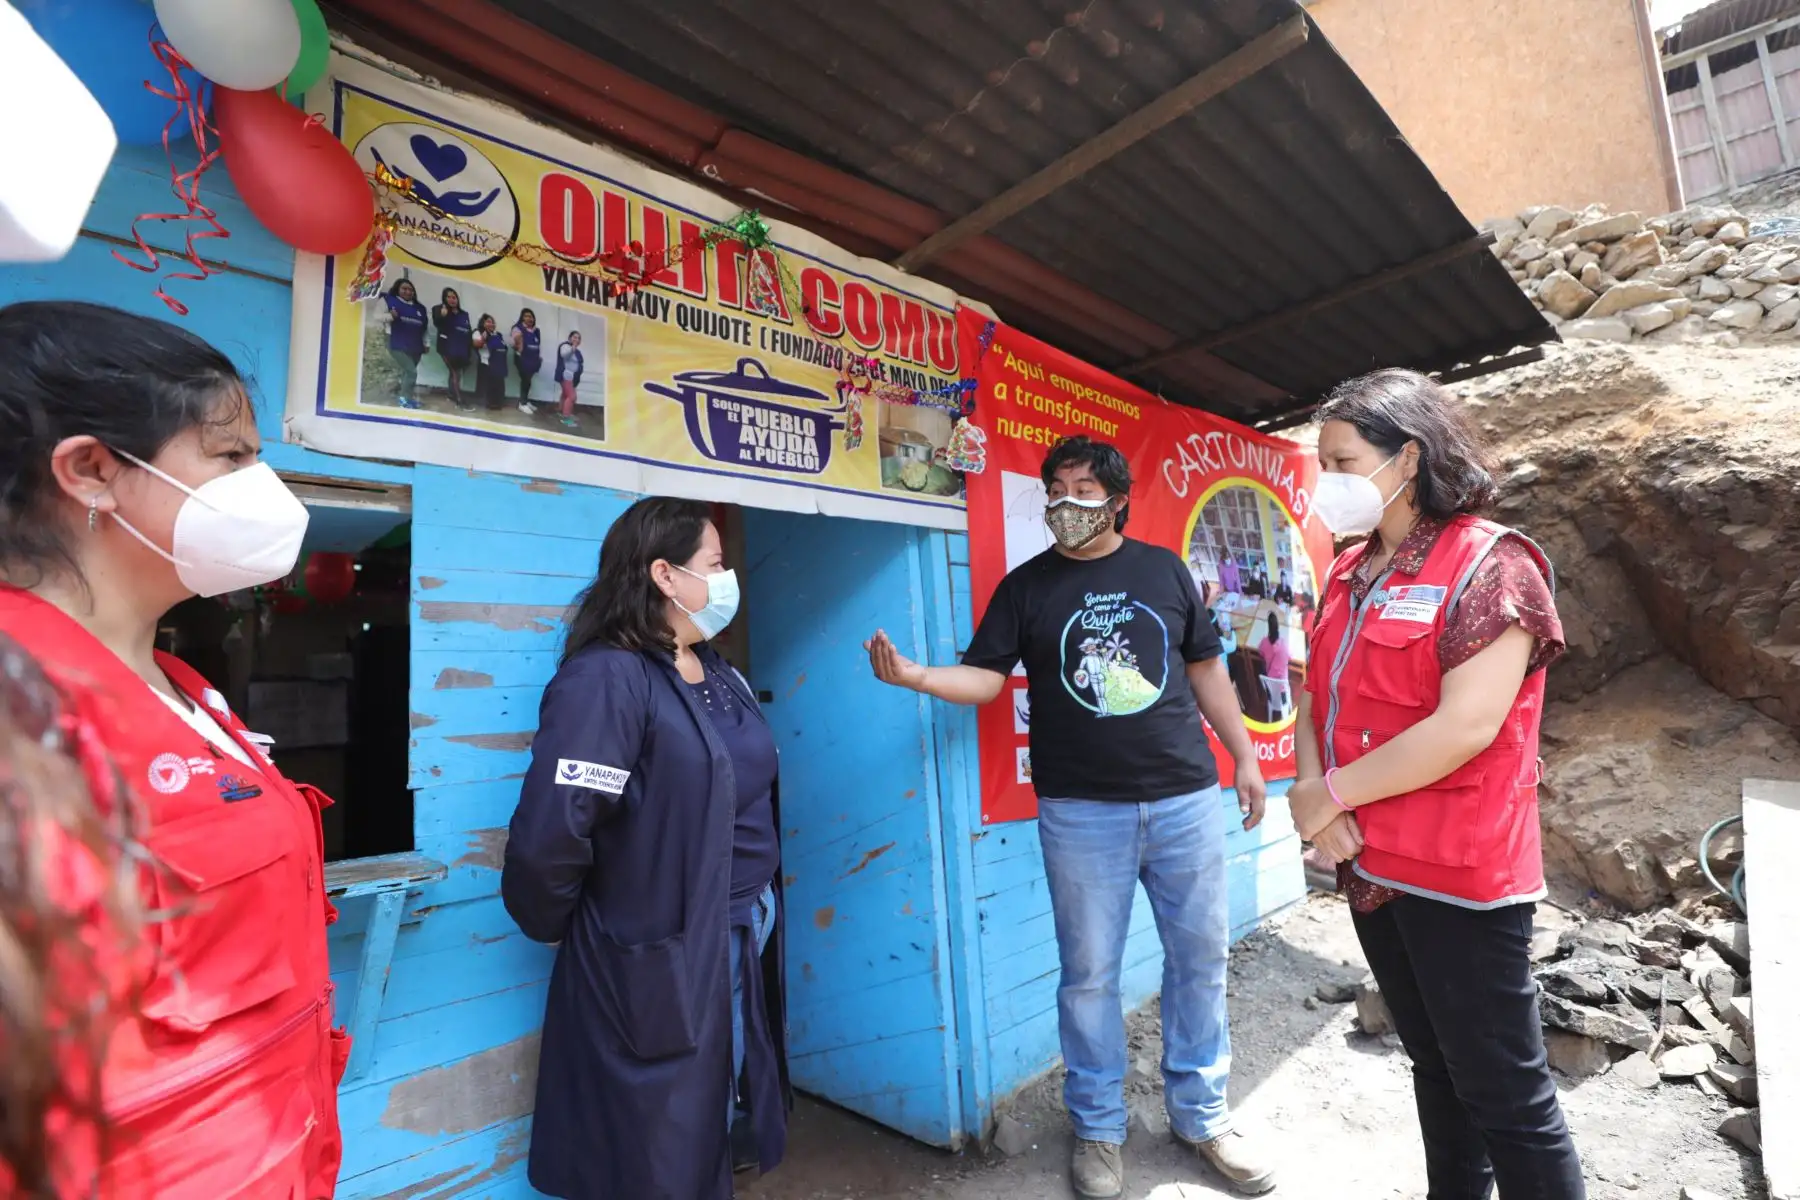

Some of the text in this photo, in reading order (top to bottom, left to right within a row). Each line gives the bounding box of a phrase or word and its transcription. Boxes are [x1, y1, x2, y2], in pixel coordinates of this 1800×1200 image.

[380, 207, 489, 248] YANAPAKUY
[542, 264, 670, 323] YANAPAKUY
[676, 302, 751, 347] QUIJOTE
[889, 364, 927, 391] MAYO
[801, 268, 958, 375] COMU
[712, 398, 740, 422] SOLO EL
[994, 382, 1119, 438] a transformar
[1050, 373, 1140, 420] empezamos
[741, 404, 816, 437] PUEBLO
[997, 417, 1064, 448] nuestr
[739, 424, 819, 456] AYUDA
[739, 446, 820, 471] AL PUEBLO!
